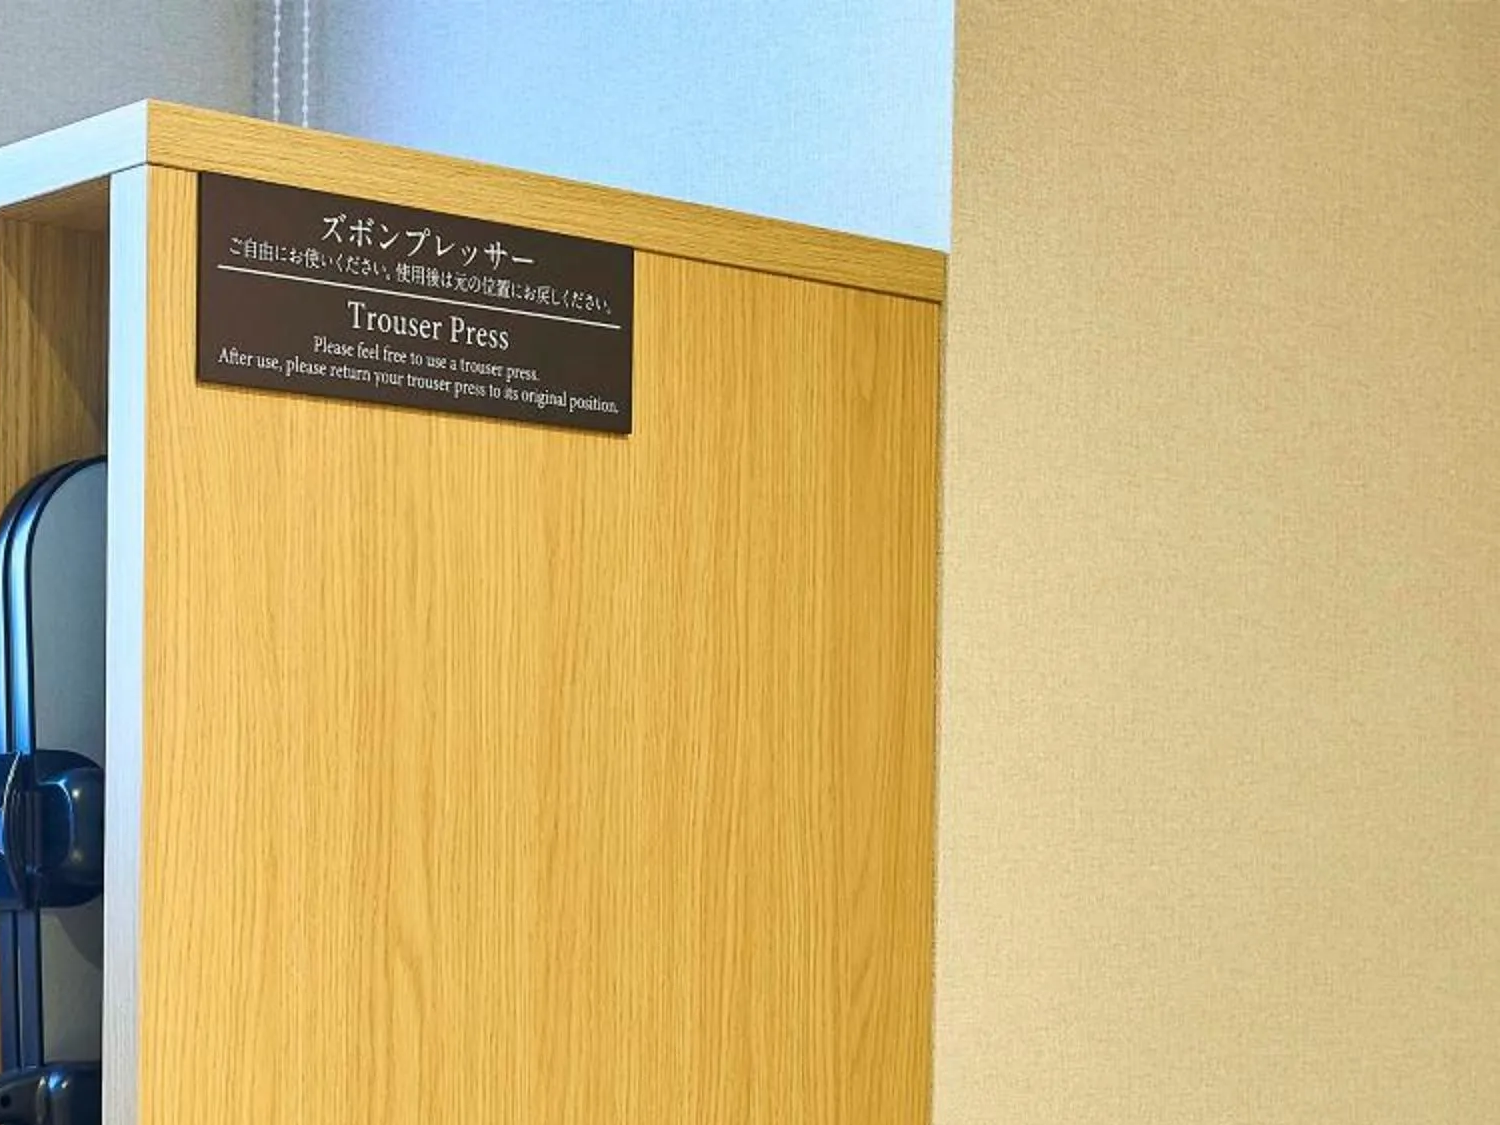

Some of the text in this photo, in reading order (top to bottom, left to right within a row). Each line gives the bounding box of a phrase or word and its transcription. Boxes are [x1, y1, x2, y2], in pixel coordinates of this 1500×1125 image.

[321, 213, 535, 270] ズボンプレッサー
[347, 301, 510, 350] Trouser Press
[218, 347, 619, 414] After use, please return your trouser press to its original position.
[313, 335, 540, 383] Please feel free to use a trouser press.
